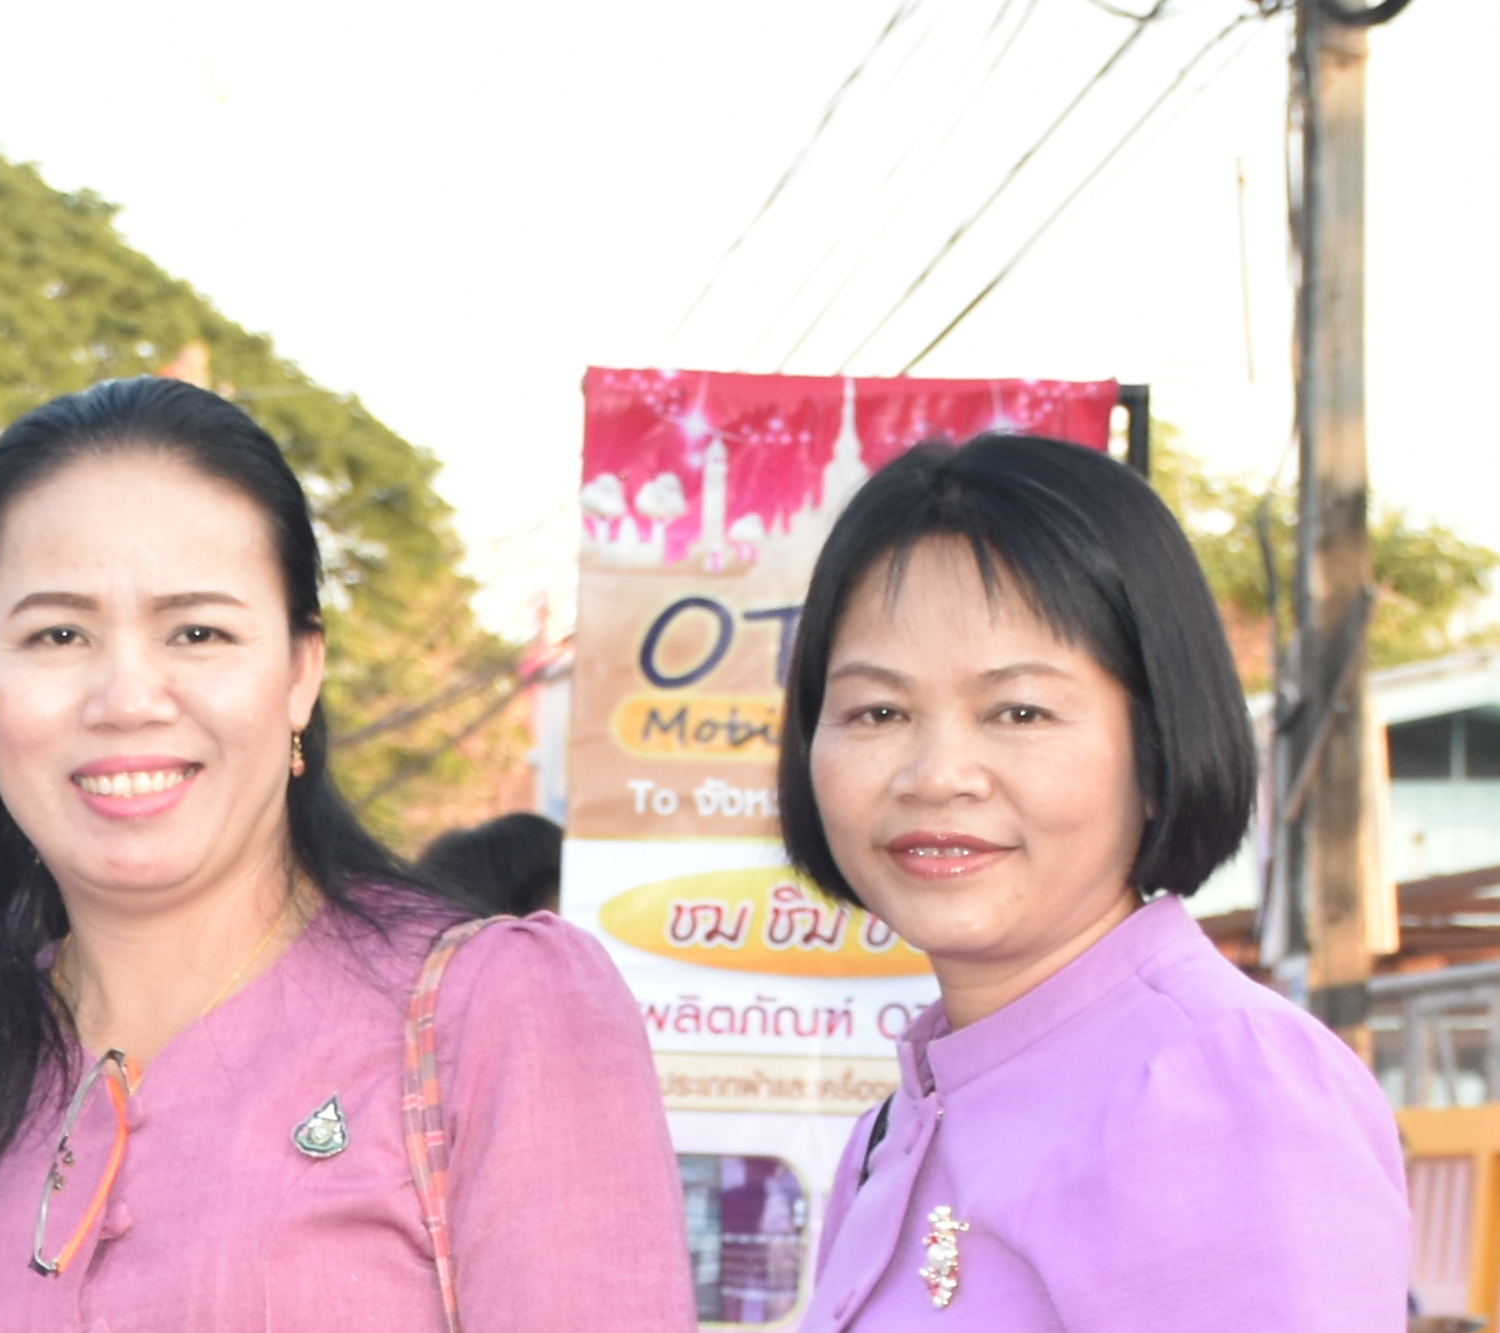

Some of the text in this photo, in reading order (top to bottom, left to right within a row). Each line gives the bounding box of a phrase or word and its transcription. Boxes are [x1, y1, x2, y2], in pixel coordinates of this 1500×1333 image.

[628, 779, 679, 816] To
[669, 903, 748, 943] ชม
[767, 885, 846, 946] ชิม
